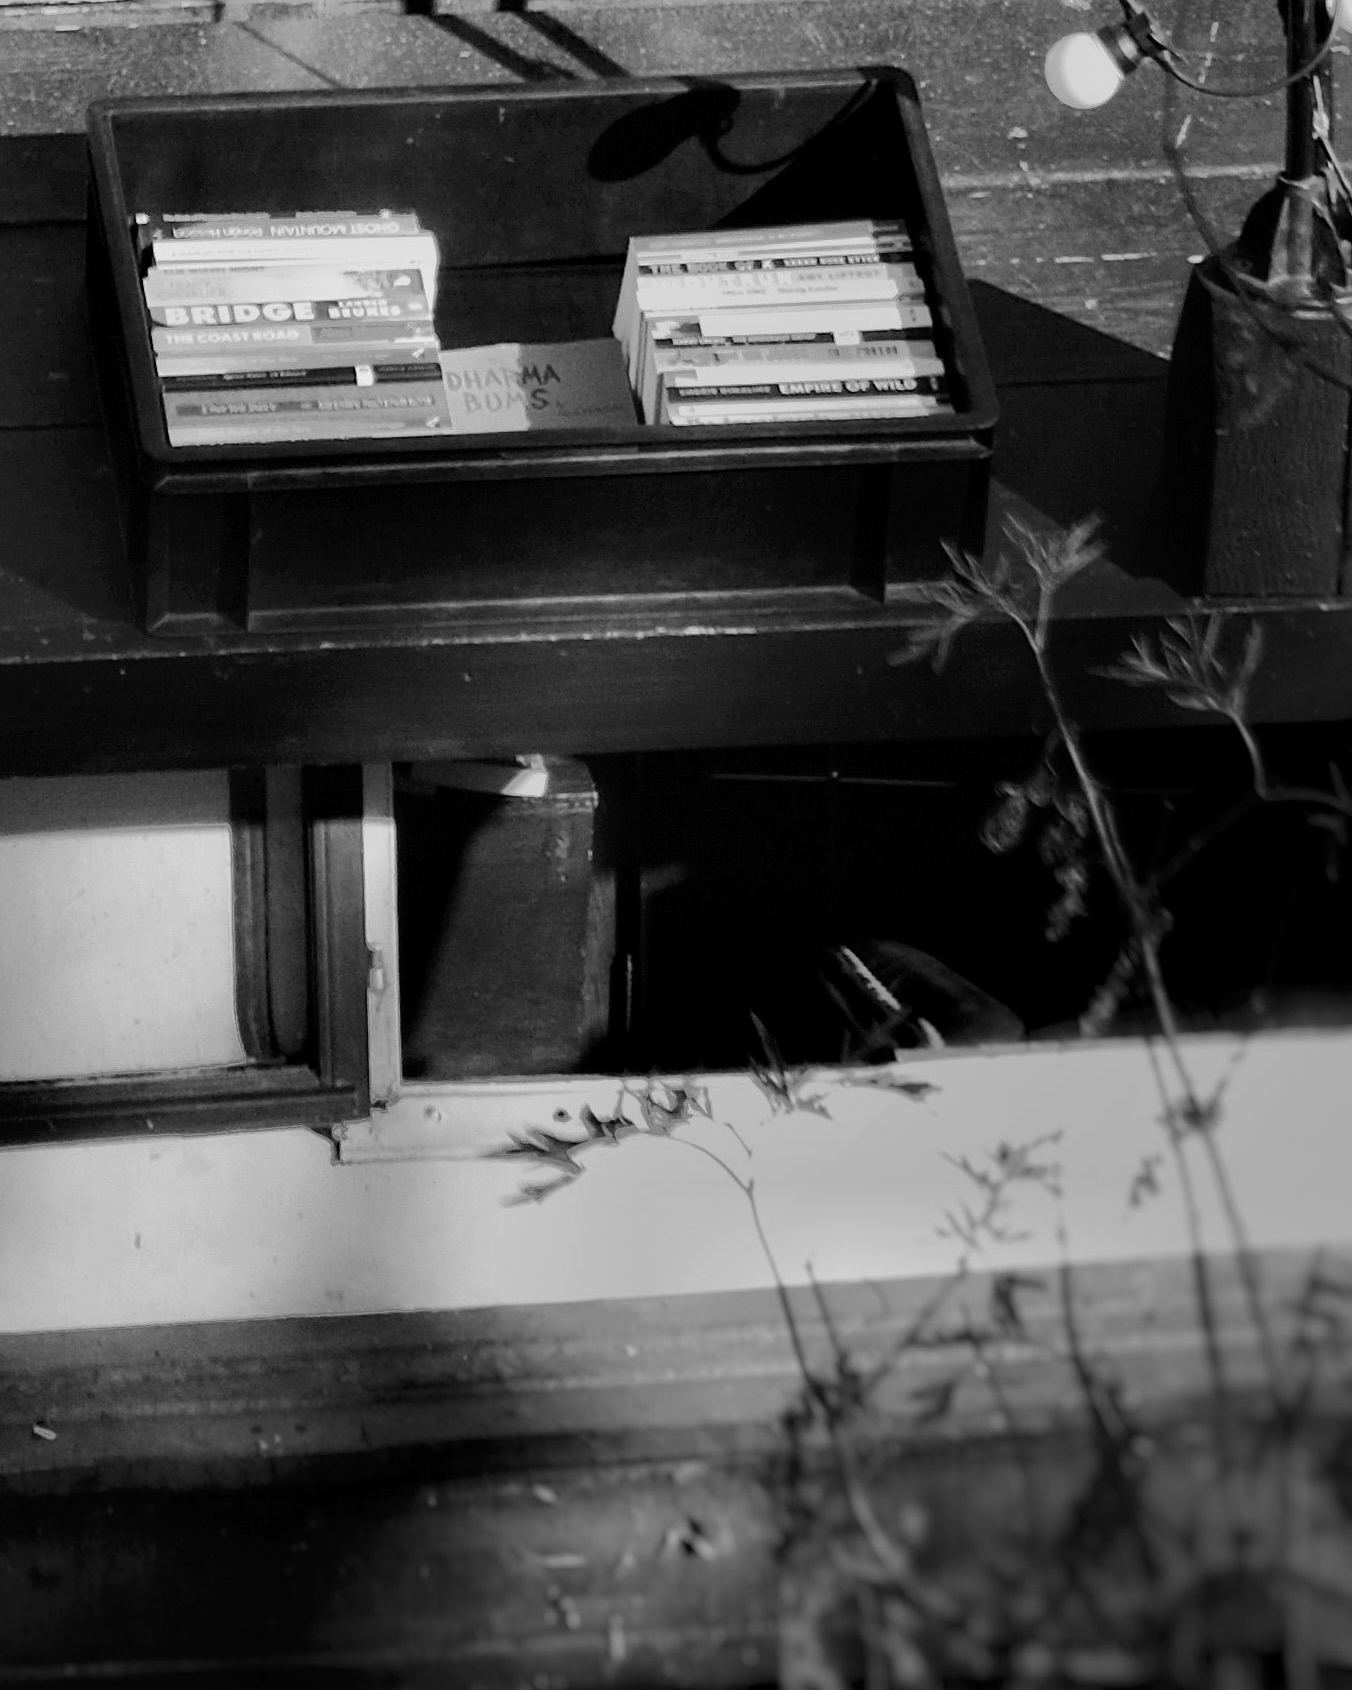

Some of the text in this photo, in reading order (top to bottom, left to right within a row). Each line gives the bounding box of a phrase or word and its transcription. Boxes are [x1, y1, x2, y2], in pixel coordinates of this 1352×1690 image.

[164, 301, 315, 326] BRIDGE
[165, 329, 299, 345] THE COAST ROAD
[778, 378, 918, 395] EMPIRE OF WILD
